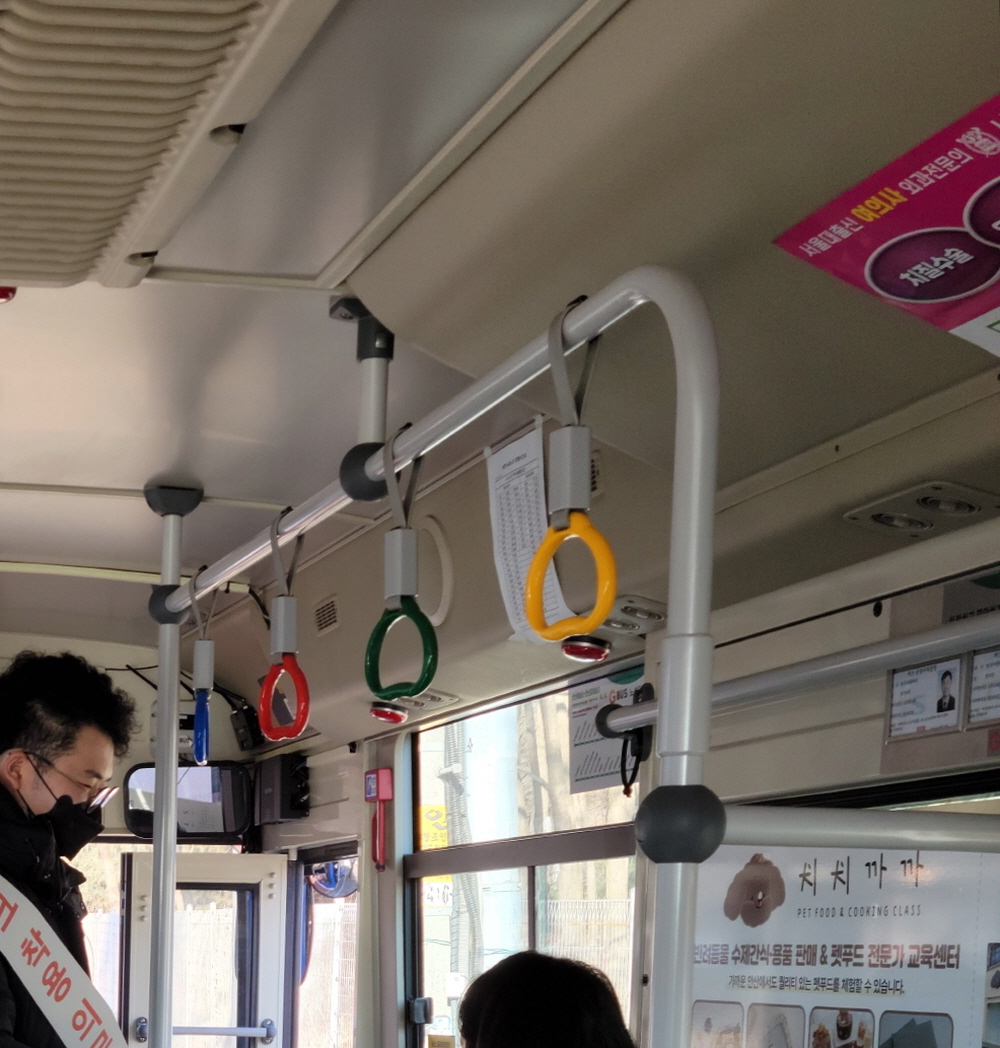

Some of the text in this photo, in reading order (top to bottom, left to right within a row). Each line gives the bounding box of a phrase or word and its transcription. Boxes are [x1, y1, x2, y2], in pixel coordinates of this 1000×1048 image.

[799, 147, 974, 257] 서울대출신 여의사 외과전문의
[899, 247, 974, 287] 치질수술
[797, 907, 812, 918] PET
[814, 907, 837, 918] FOOD
[847, 905, 889, 917] COOKING
[892, 904, 921, 917] CLASS
[19, 927, 72, 1003] 착용
[795, 944, 818, 967] 판매
[819, 943, 829, 966] &
[830, 943, 865, 968] 펫푸드
[867, 943, 906, 969] 전문가
[907, 943, 960, 970] 교육센터
[798, 977, 812, 991] 있는
[813, 976, 840, 992] 펫푸드를
[841, 978, 862, 994] 체험할
[863, 980, 873, 994] 수
[873, 979, 906, 996] 있습니다.
